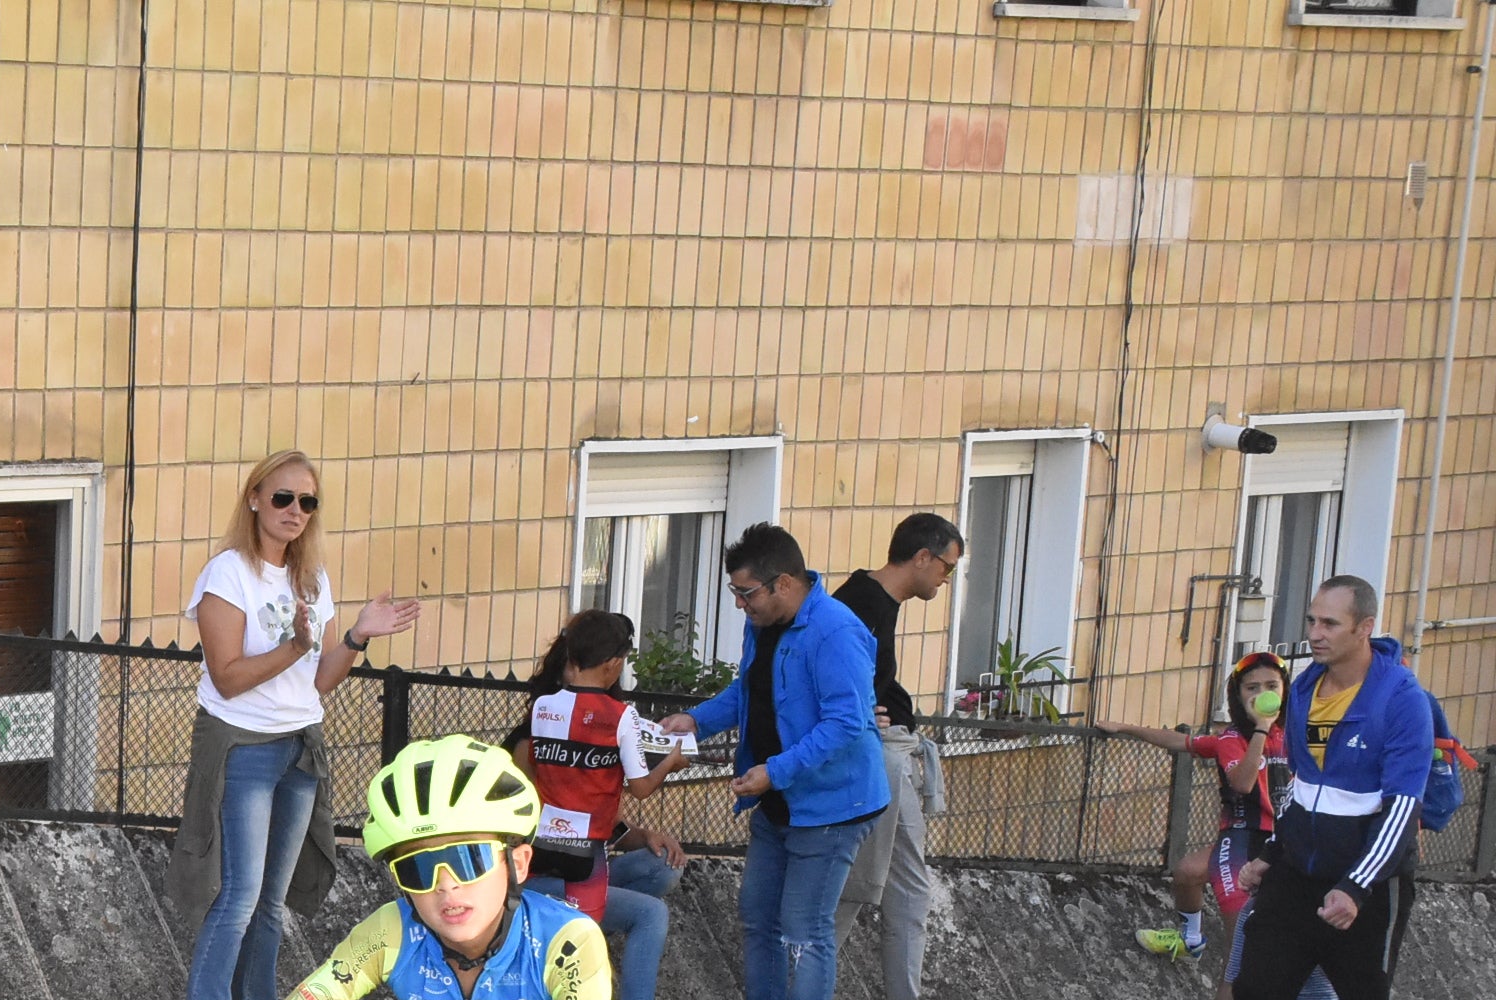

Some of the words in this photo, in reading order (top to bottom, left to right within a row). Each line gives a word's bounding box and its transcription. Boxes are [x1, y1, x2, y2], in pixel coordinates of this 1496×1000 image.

[570, 751, 581, 767] y
[584, 748, 618, 767] León
[1219, 837, 1231, 864] CAJA
[1220, 864, 1235, 897] RURAL
